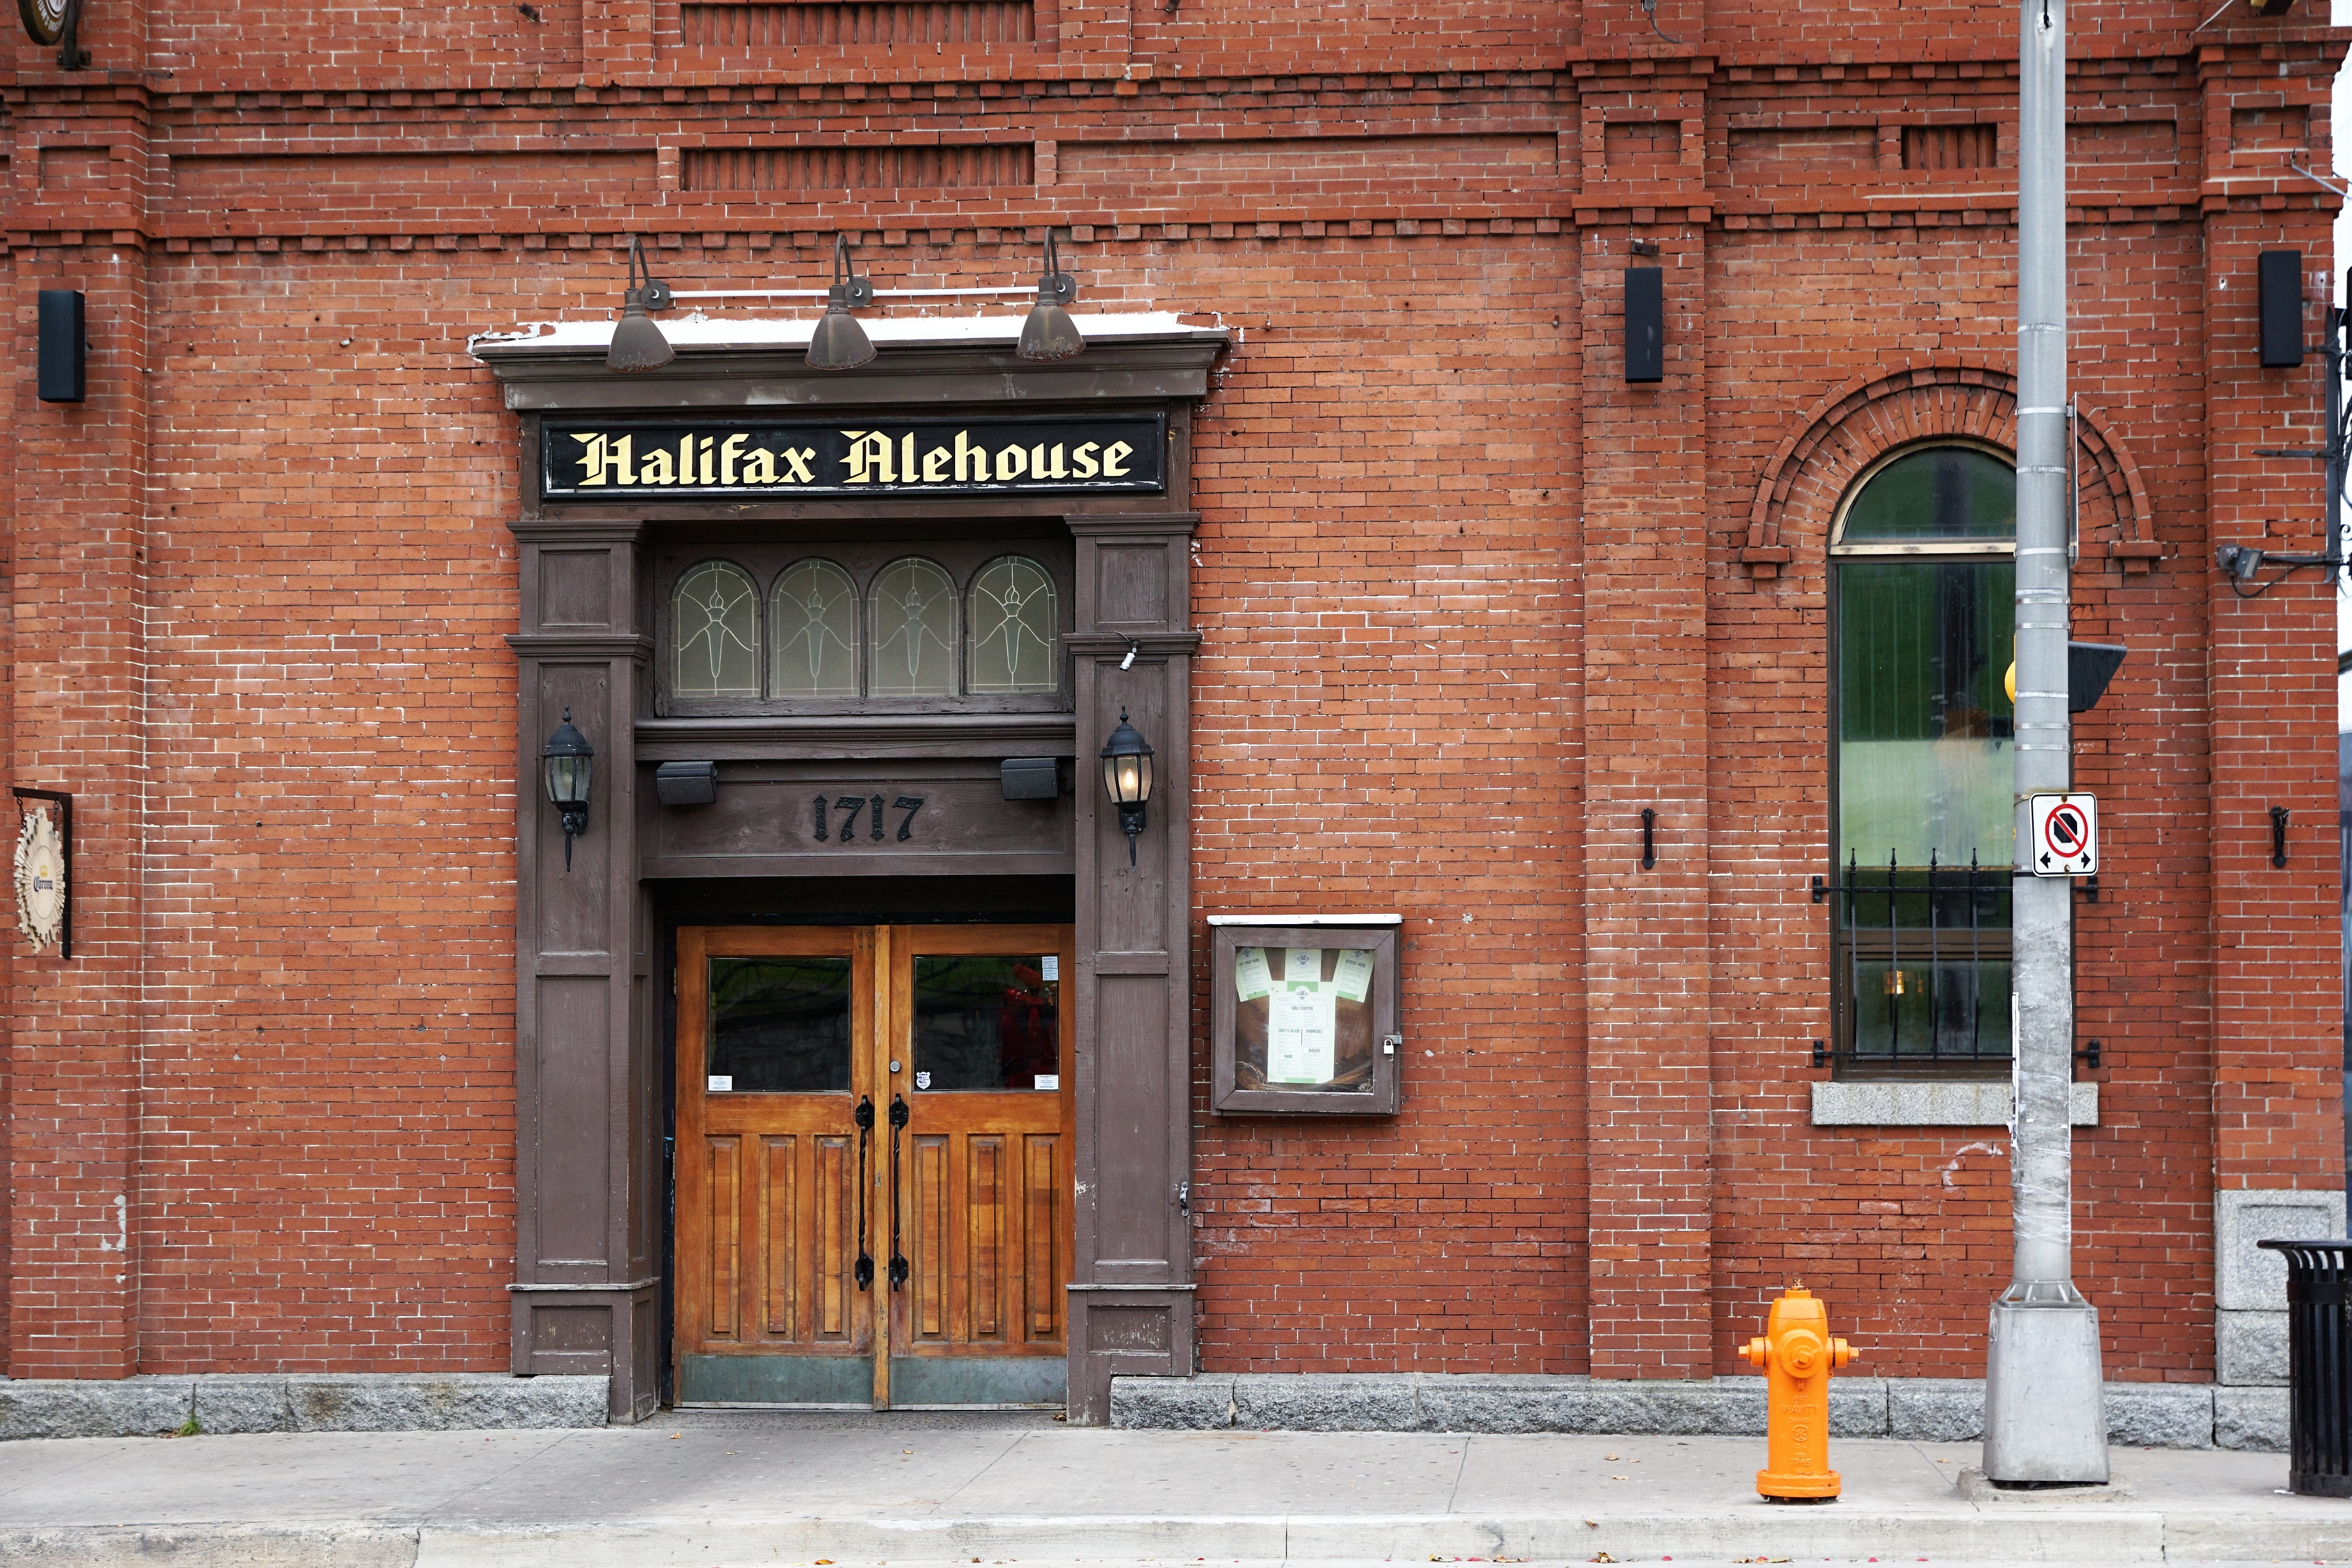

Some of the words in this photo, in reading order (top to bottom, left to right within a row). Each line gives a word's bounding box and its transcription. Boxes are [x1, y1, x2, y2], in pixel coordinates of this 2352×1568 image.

[570, 433, 816, 485] Halifax
[839, 430, 1133, 483] Alehouse
[813, 794, 924, 842] 1717
[34, 876, 53, 894] Corona
